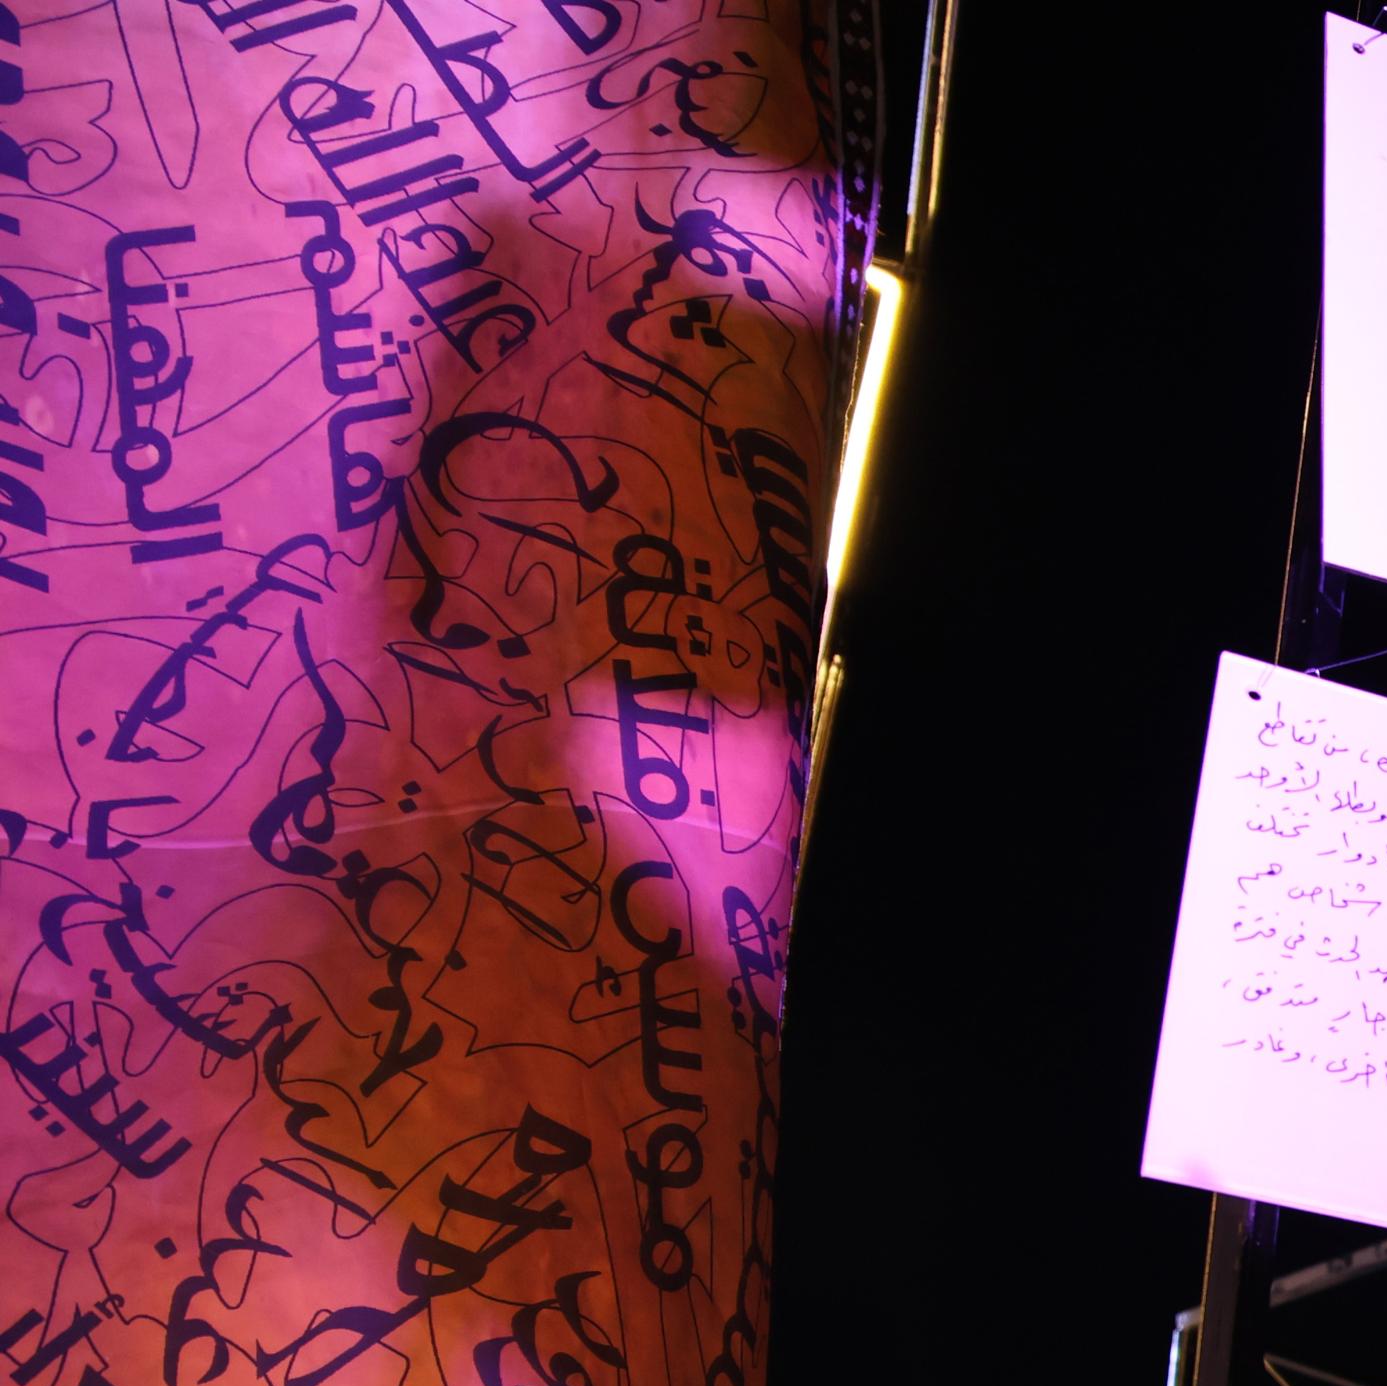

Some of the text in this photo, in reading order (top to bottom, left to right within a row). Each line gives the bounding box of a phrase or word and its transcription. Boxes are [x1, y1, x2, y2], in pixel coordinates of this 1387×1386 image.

[1255, 699, 1328, 748] تقاطع
[1321, 733, 1350, 758] من
[1233, 759, 1321, 803] الأوحد
[1328, 778, 1377, 825] بطلها
[1235, 861, 1284, 895] هم
[1231, 903, 1280, 943] فترة
[1278, 919, 1307, 960] في
[1314, 933, 1361, 981] الحدث
[1220, 970, 1320, 1008] متدفق،
[1220, 1026, 1302, 1064] وغادر
